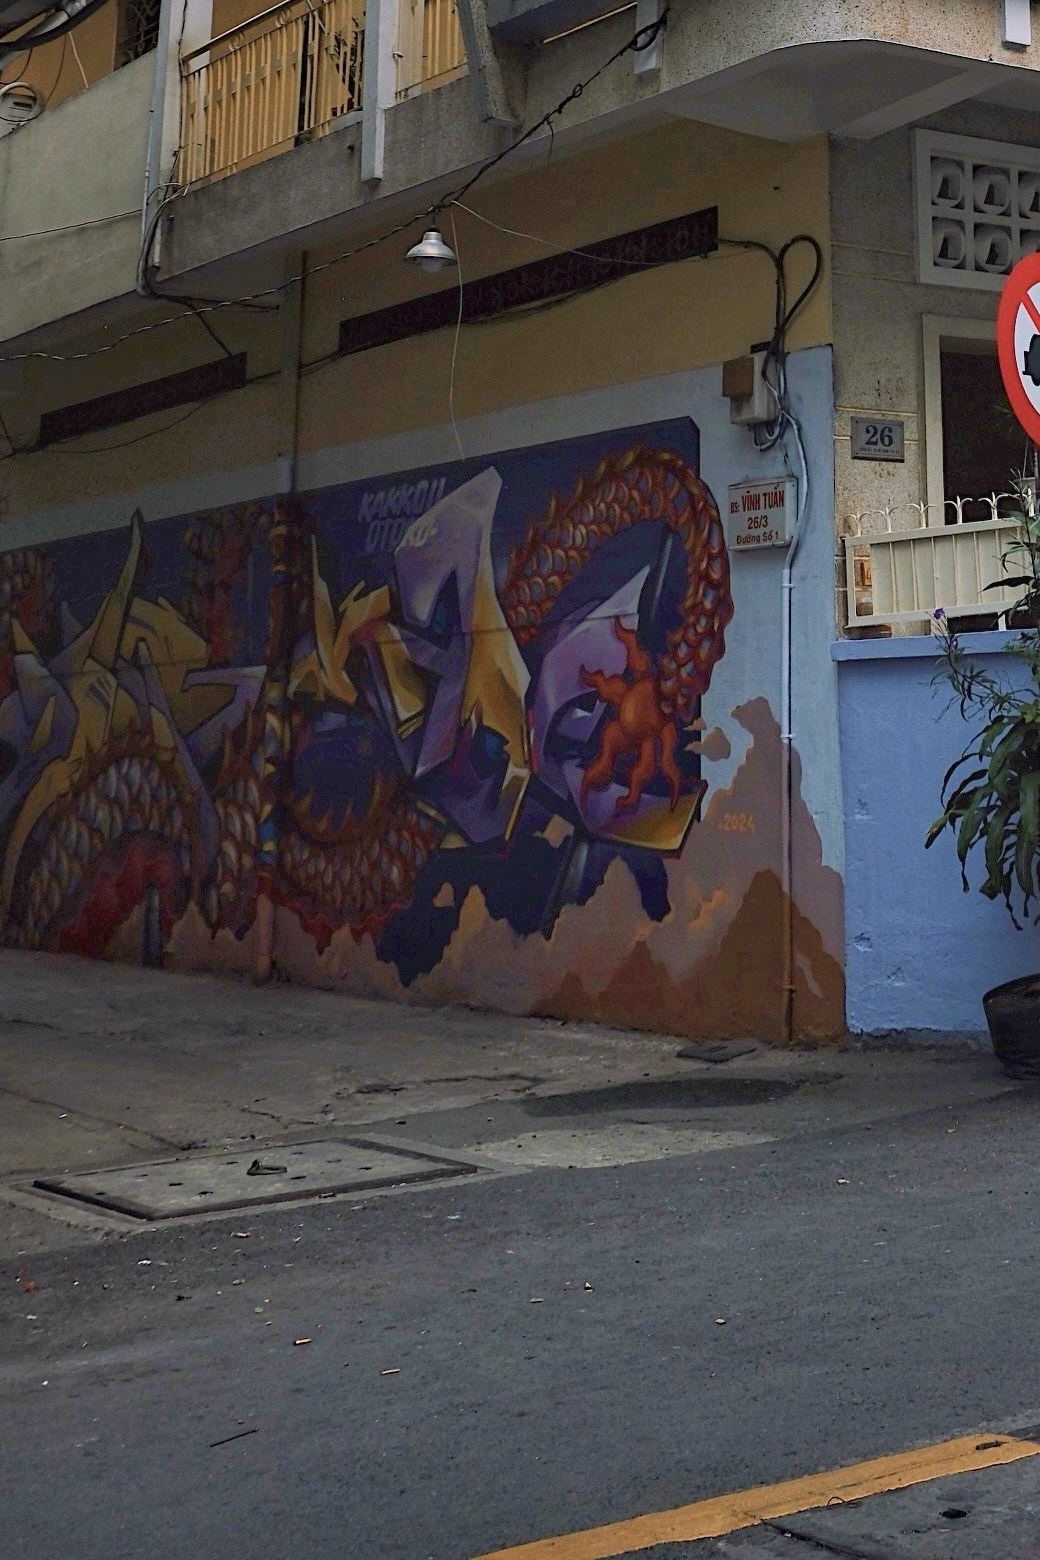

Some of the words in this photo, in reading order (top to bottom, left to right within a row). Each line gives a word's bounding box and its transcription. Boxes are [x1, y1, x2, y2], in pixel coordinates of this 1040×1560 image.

[865, 425, 894, 447] 26
[730, 501, 740, 514] BS:
[741, 490, 761, 512] VĨNH
[762, 483, 785, 510] TUẤN
[747, 515, 769, 530] 26/3
[736, 533, 761, 545] Đường
[762, 529, 774, 542] Số
